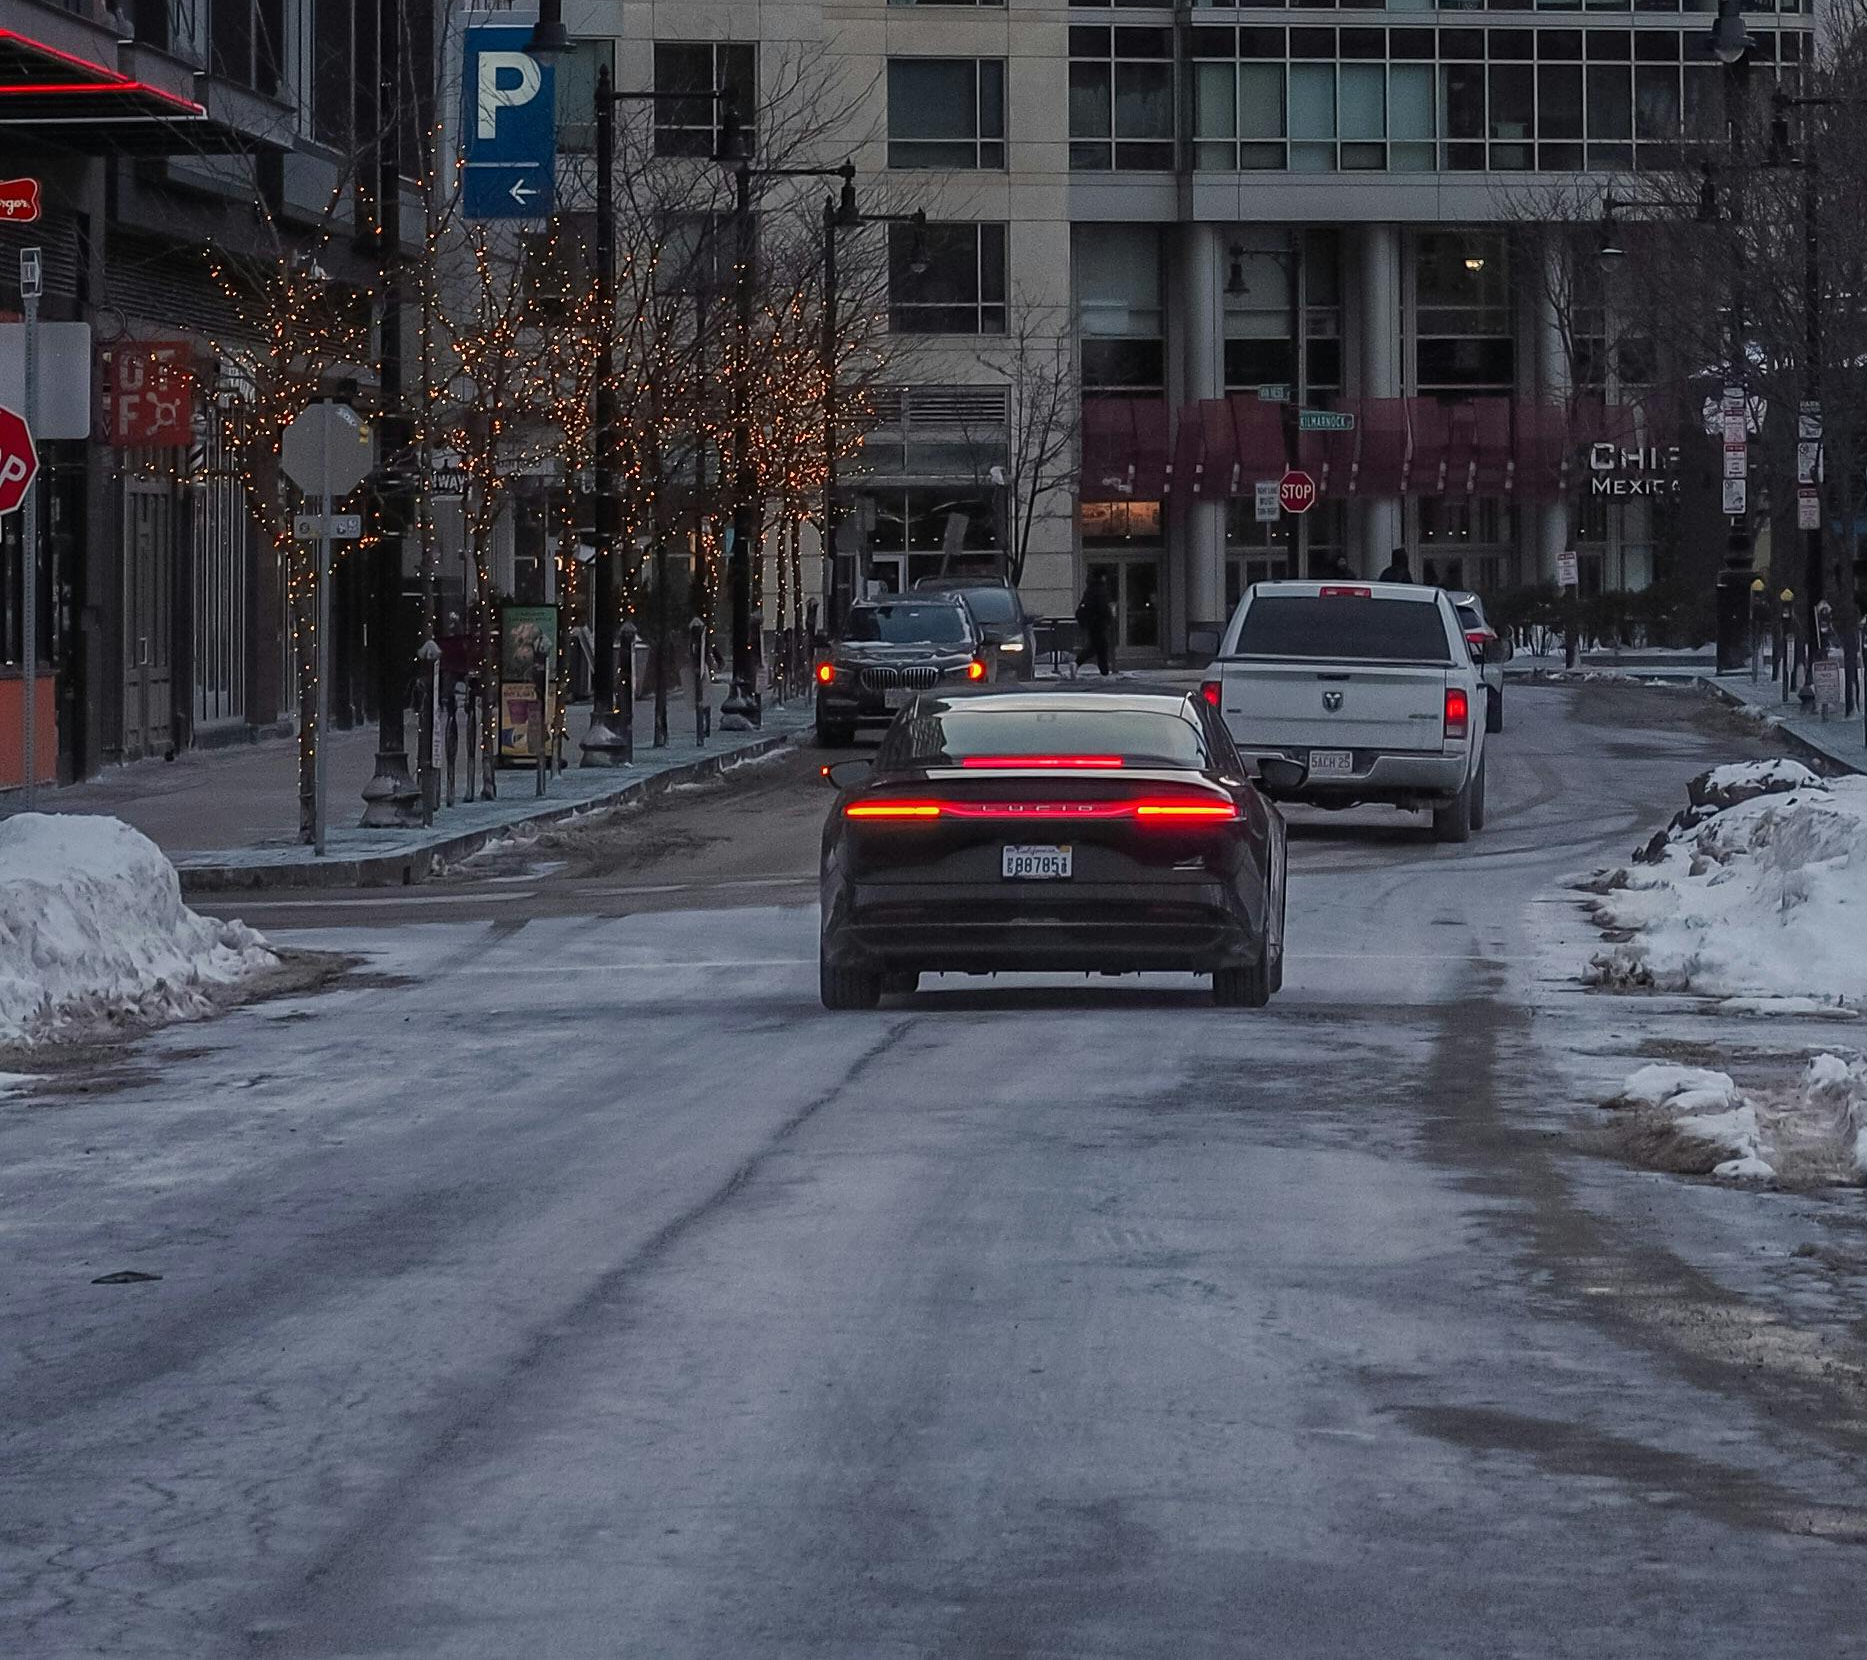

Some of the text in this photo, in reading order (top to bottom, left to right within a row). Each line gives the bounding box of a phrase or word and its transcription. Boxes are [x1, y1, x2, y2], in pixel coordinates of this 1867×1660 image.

[478, 51, 541, 139] P
[1300, 416, 1345, 428] KILMARNOCK
[1281, 484, 1312, 499] STOP
[1015, 856, 1059, 873] 88785
